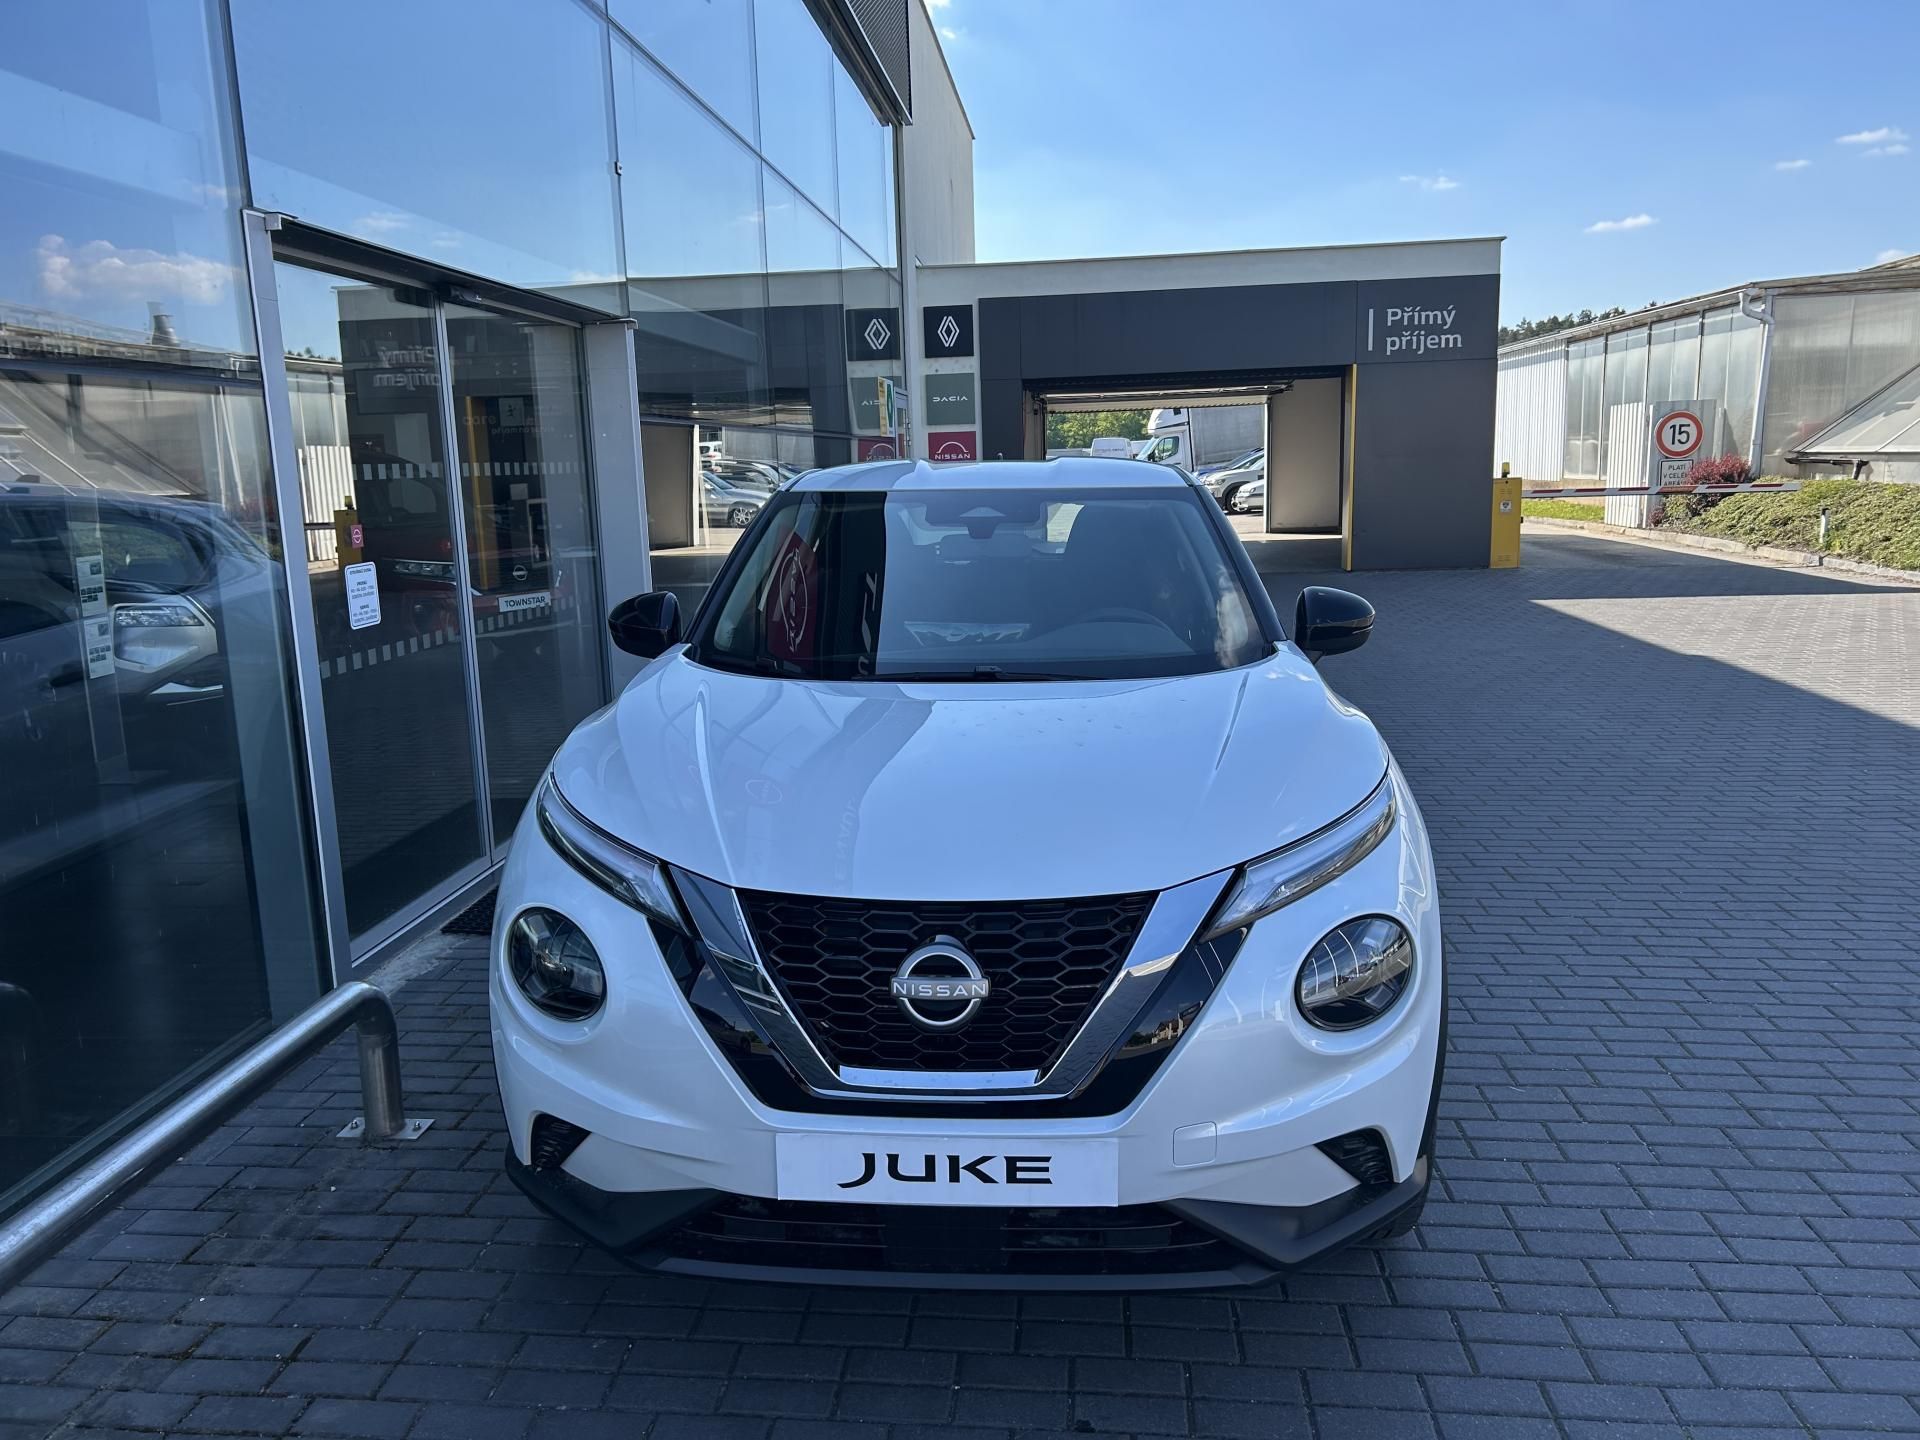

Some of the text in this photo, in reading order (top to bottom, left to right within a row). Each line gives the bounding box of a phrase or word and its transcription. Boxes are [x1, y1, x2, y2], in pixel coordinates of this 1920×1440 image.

[1386, 305, 1457, 330] Přímý
[1385, 330, 1463, 356] příjem
[932, 395, 969, 403] DACIA
[1669, 423, 1691, 446] 15
[934, 453, 971, 461] NISSAN
[504, 596, 546, 607] TOWNSTAR
[893, 982, 986, 997] NISSAN
[836, 1152, 1053, 1189] JUKE
